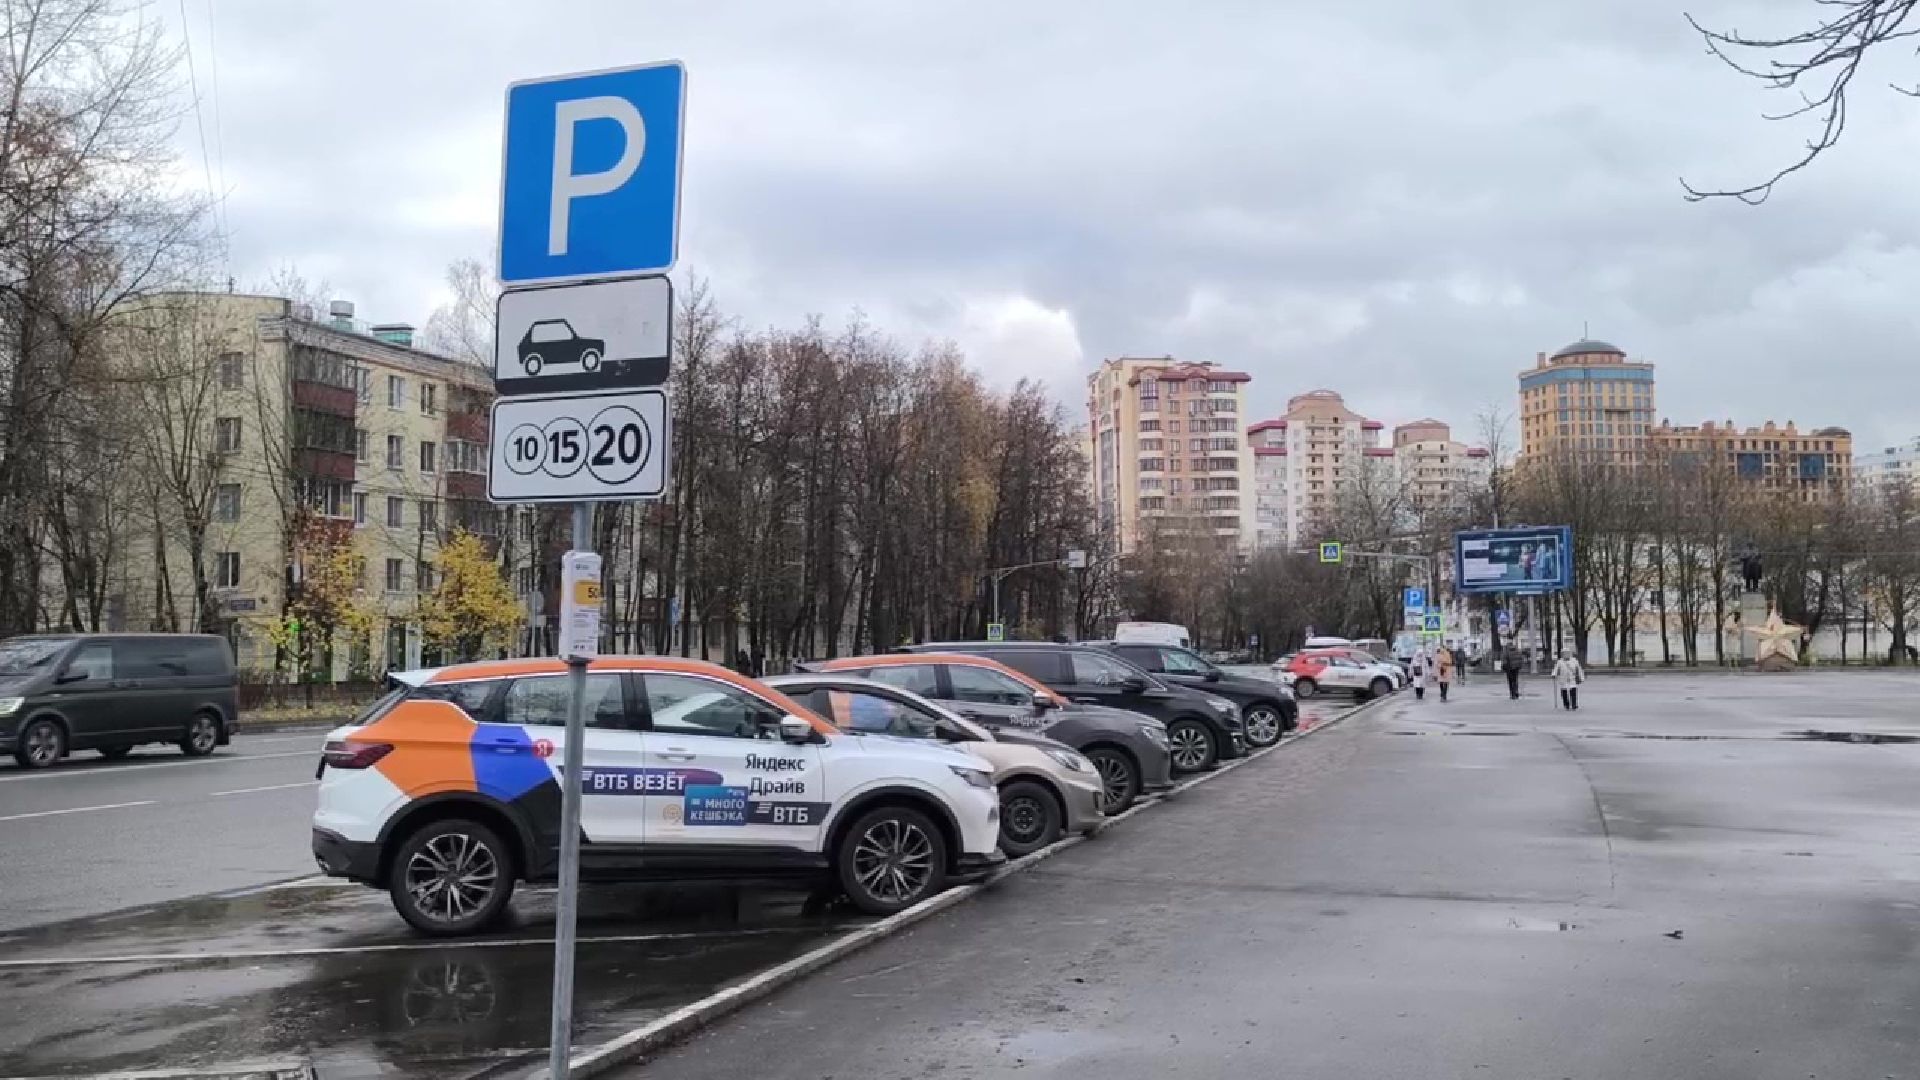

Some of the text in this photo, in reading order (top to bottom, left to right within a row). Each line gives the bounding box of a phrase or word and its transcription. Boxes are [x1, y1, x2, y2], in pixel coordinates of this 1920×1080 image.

[548, 95, 646, 256] P
[513, 423, 643, 466] 10 15 20
[745, 753, 805, 772] Яндекс
[594, 771, 686, 790] ВТБ ВЕЗЁТ
[749, 777, 805, 796] Драйв
[704, 798, 745, 809] МНОГО
[773, 806, 808, 823] ВТБ
